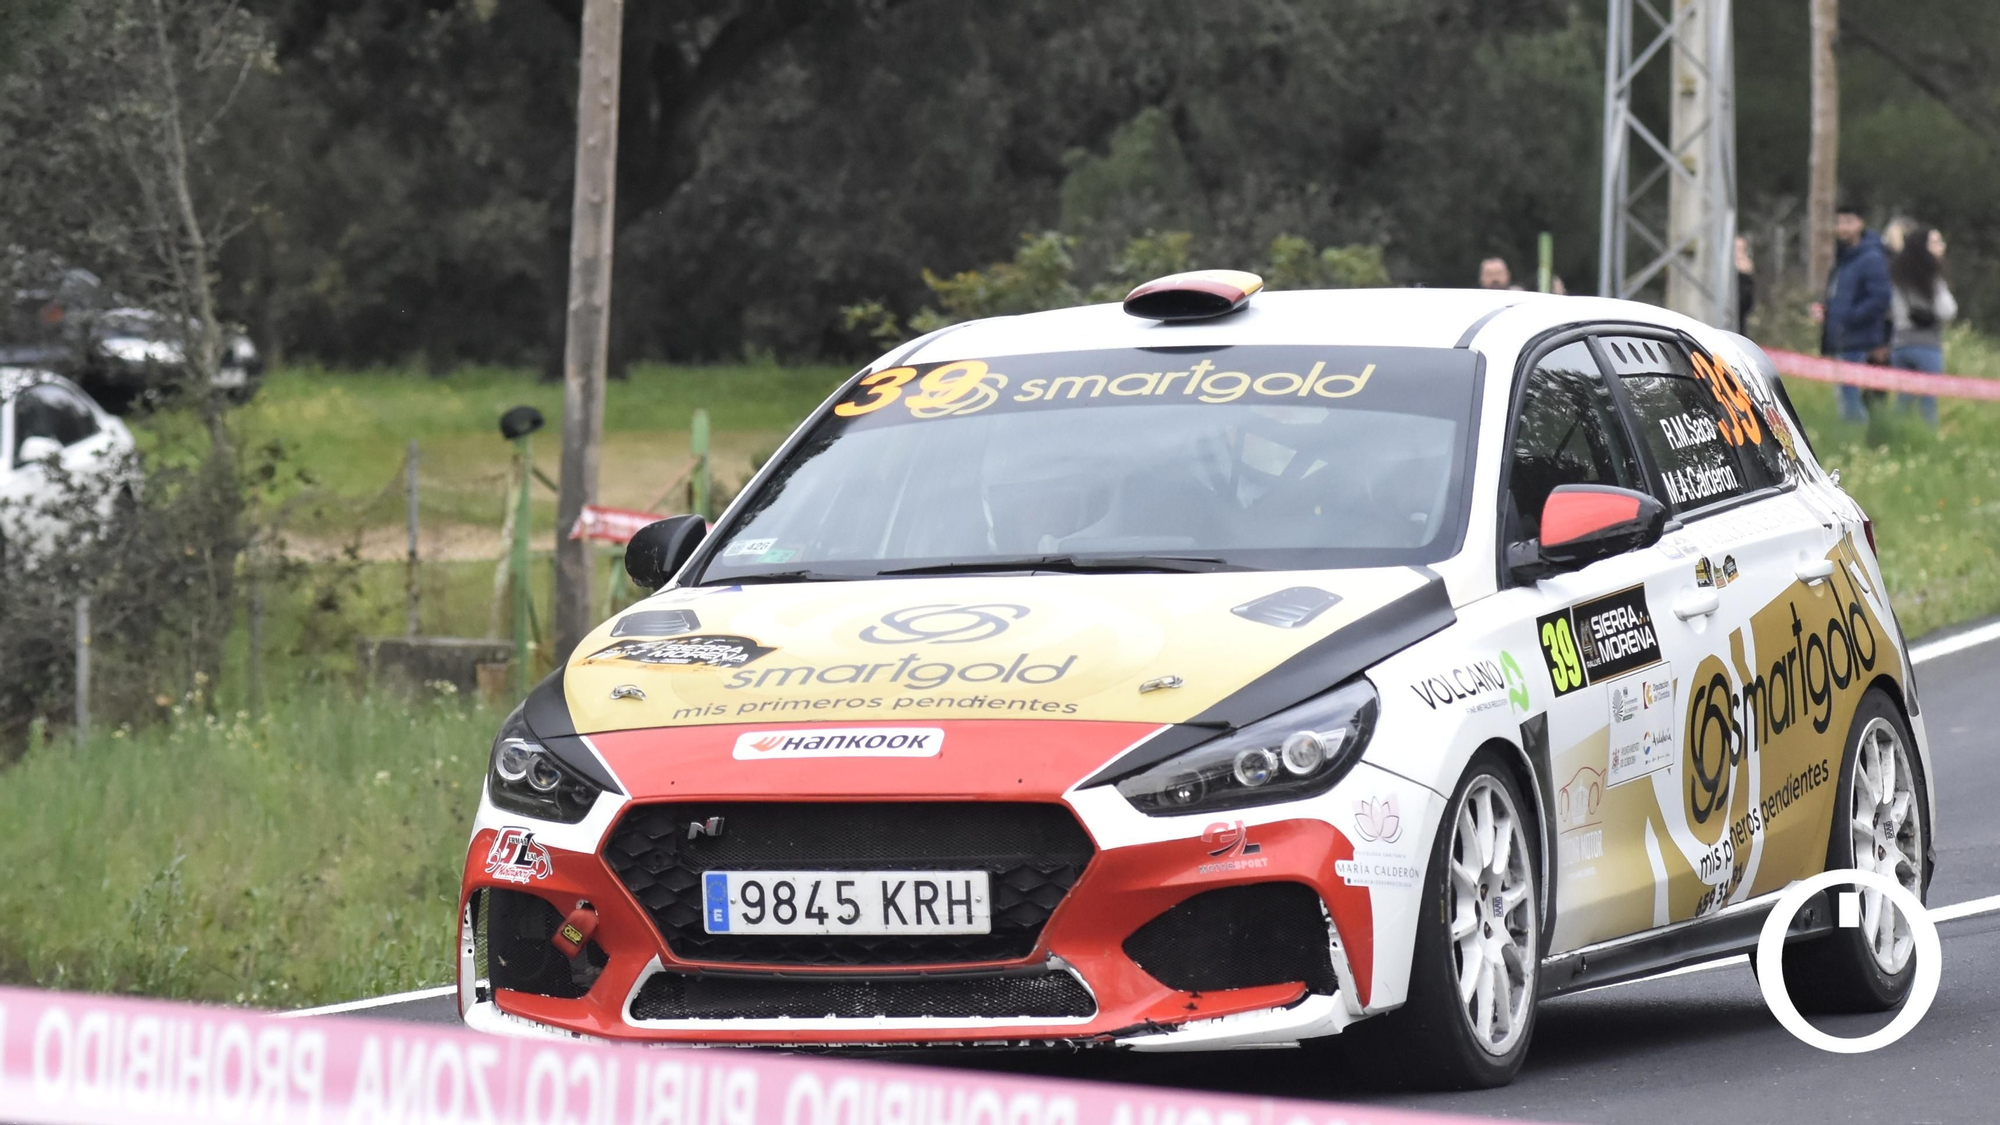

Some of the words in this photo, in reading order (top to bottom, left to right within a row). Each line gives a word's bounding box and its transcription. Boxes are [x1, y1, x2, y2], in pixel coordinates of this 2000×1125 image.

[834, 359, 988, 417] 39
[1013, 358, 1376, 403] smartgold
[1690, 351, 1762, 447] 39
[1659, 413, 1717, 450] R.M.Saco
[1590, 604, 1640, 640] SIERRA
[1541, 617, 1582, 692] 39
[1597, 625, 1657, 664] MORENA
[1730, 558, 1877, 768] smartgold
[723, 653, 1079, 691] smartgold
[1410, 659, 1505, 710] VOLCANO
[671, 702, 727, 720] mis
[736, 695, 885, 717] primeros
[891, 694, 1080, 715] pendientes
[1699, 842, 1722, 881] mis
[1760, 758, 1830, 831] pendientes
[1337, 861, 1370, 875] MARÍA
[1374, 864, 1420, 879] CALDERÓN
[713, 909, 723, 922] E
[740, 880, 861, 925] 9845
[881, 879, 974, 926] KRH
[563, 925, 582, 942] OMP
